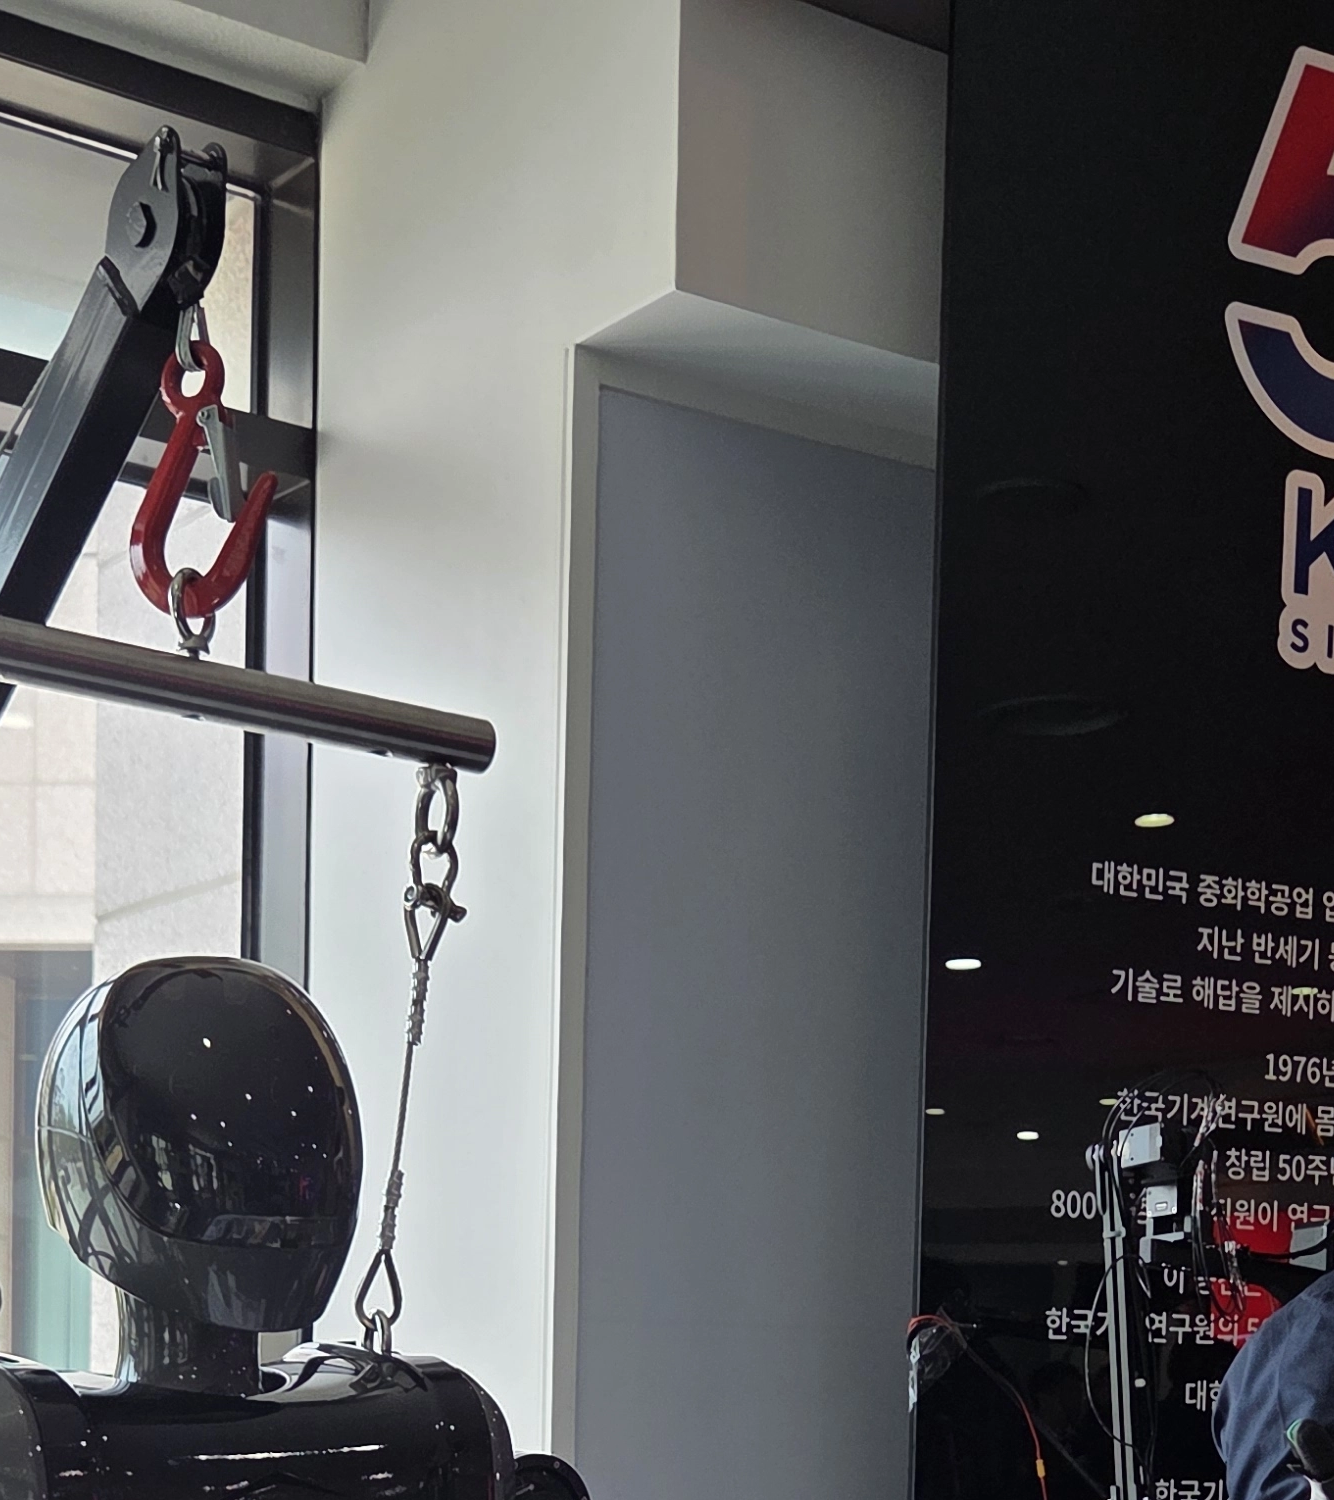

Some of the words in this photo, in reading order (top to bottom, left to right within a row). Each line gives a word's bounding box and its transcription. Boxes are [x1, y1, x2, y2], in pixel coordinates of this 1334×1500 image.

[1091, 861, 1189, 904] 대한민국
[1197, 874, 1314, 920] 중화학공업
[1197, 926, 1245, 962] 지난
[1252, 933, 1320, 971] 반세기
[1111, 968, 1184, 1004] 기술로
[1192, 976, 1263, 1015] 해답을
[1225, 1147, 1270, 1183] 창립
